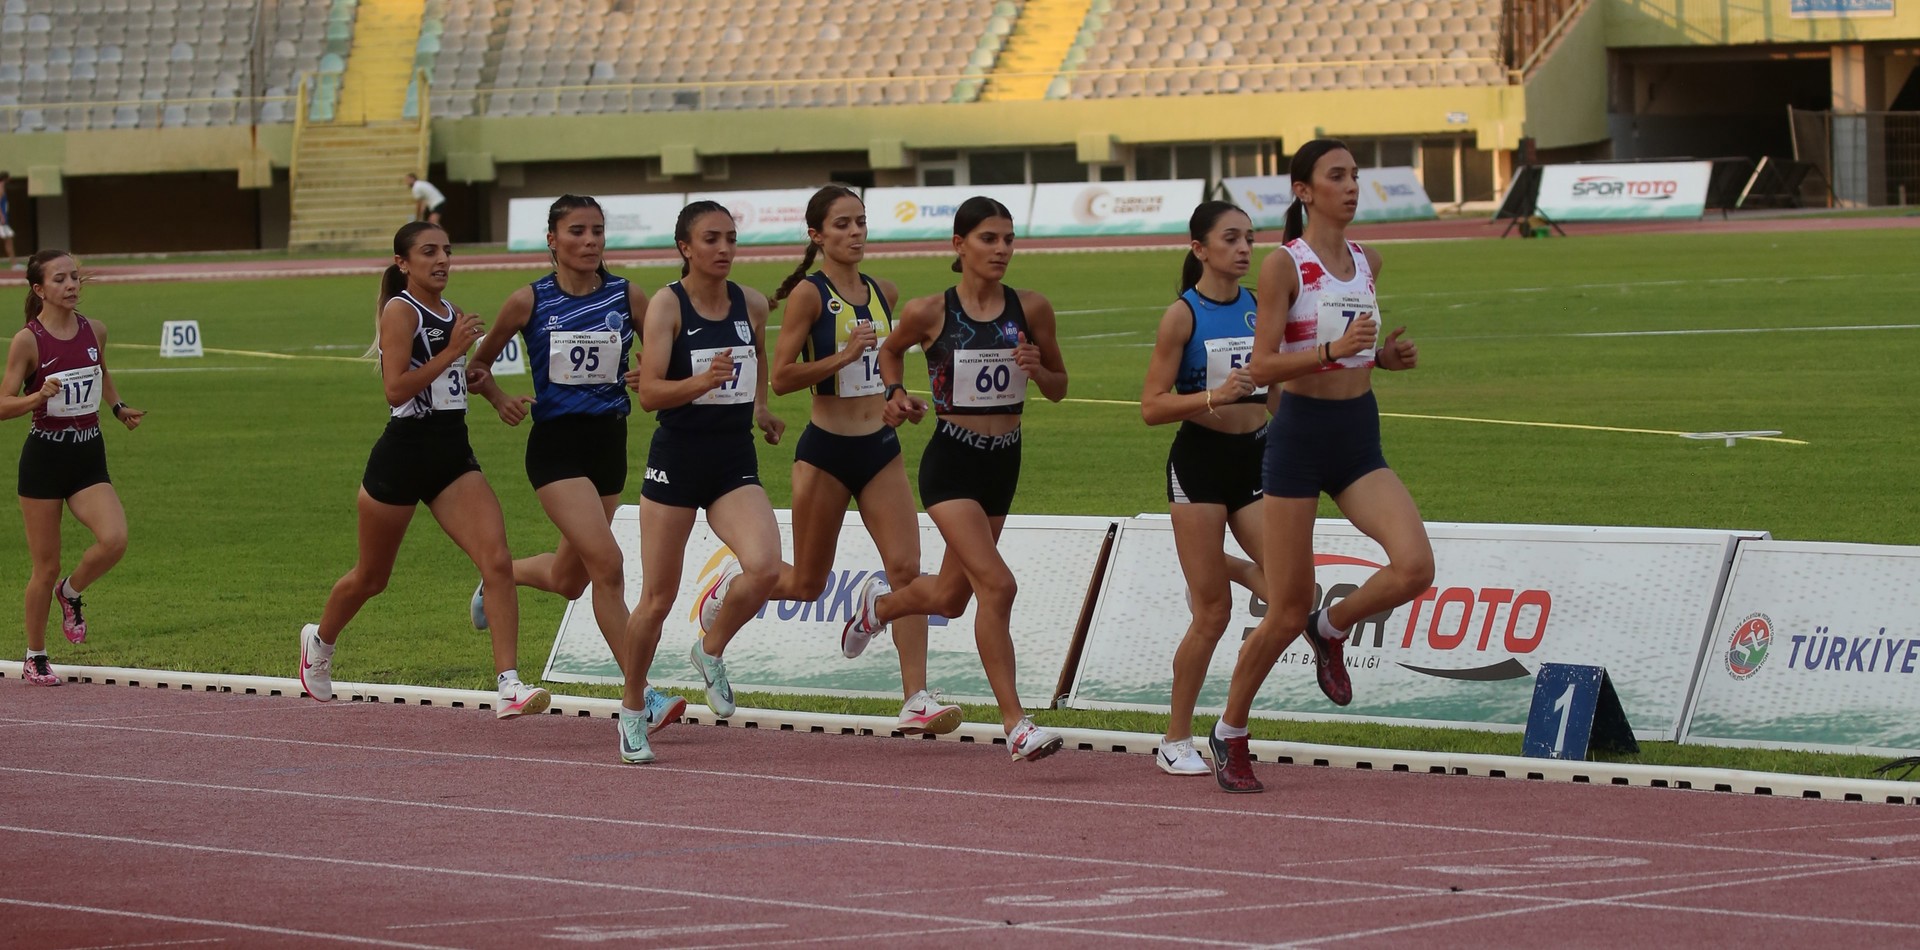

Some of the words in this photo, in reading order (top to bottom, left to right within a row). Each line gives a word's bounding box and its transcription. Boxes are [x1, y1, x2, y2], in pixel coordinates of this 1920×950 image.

[1342, 310, 1367, 335] 7
[570, 345, 600, 372] 95
[863, 355, 882, 381] 14
[1230, 352, 1252, 369] 5
[975, 364, 1010, 393] 60
[63, 379, 94, 405] 117
[73, 427, 99, 443] NIKE
[942, 420, 990, 450] NIKE
[990, 428, 1020, 451] PRO
[1302, 654, 1380, 669] BANLIĞI
[1788, 626, 1920, 674] TÜRKİYE
[1553, 684, 1576, 752] 1
